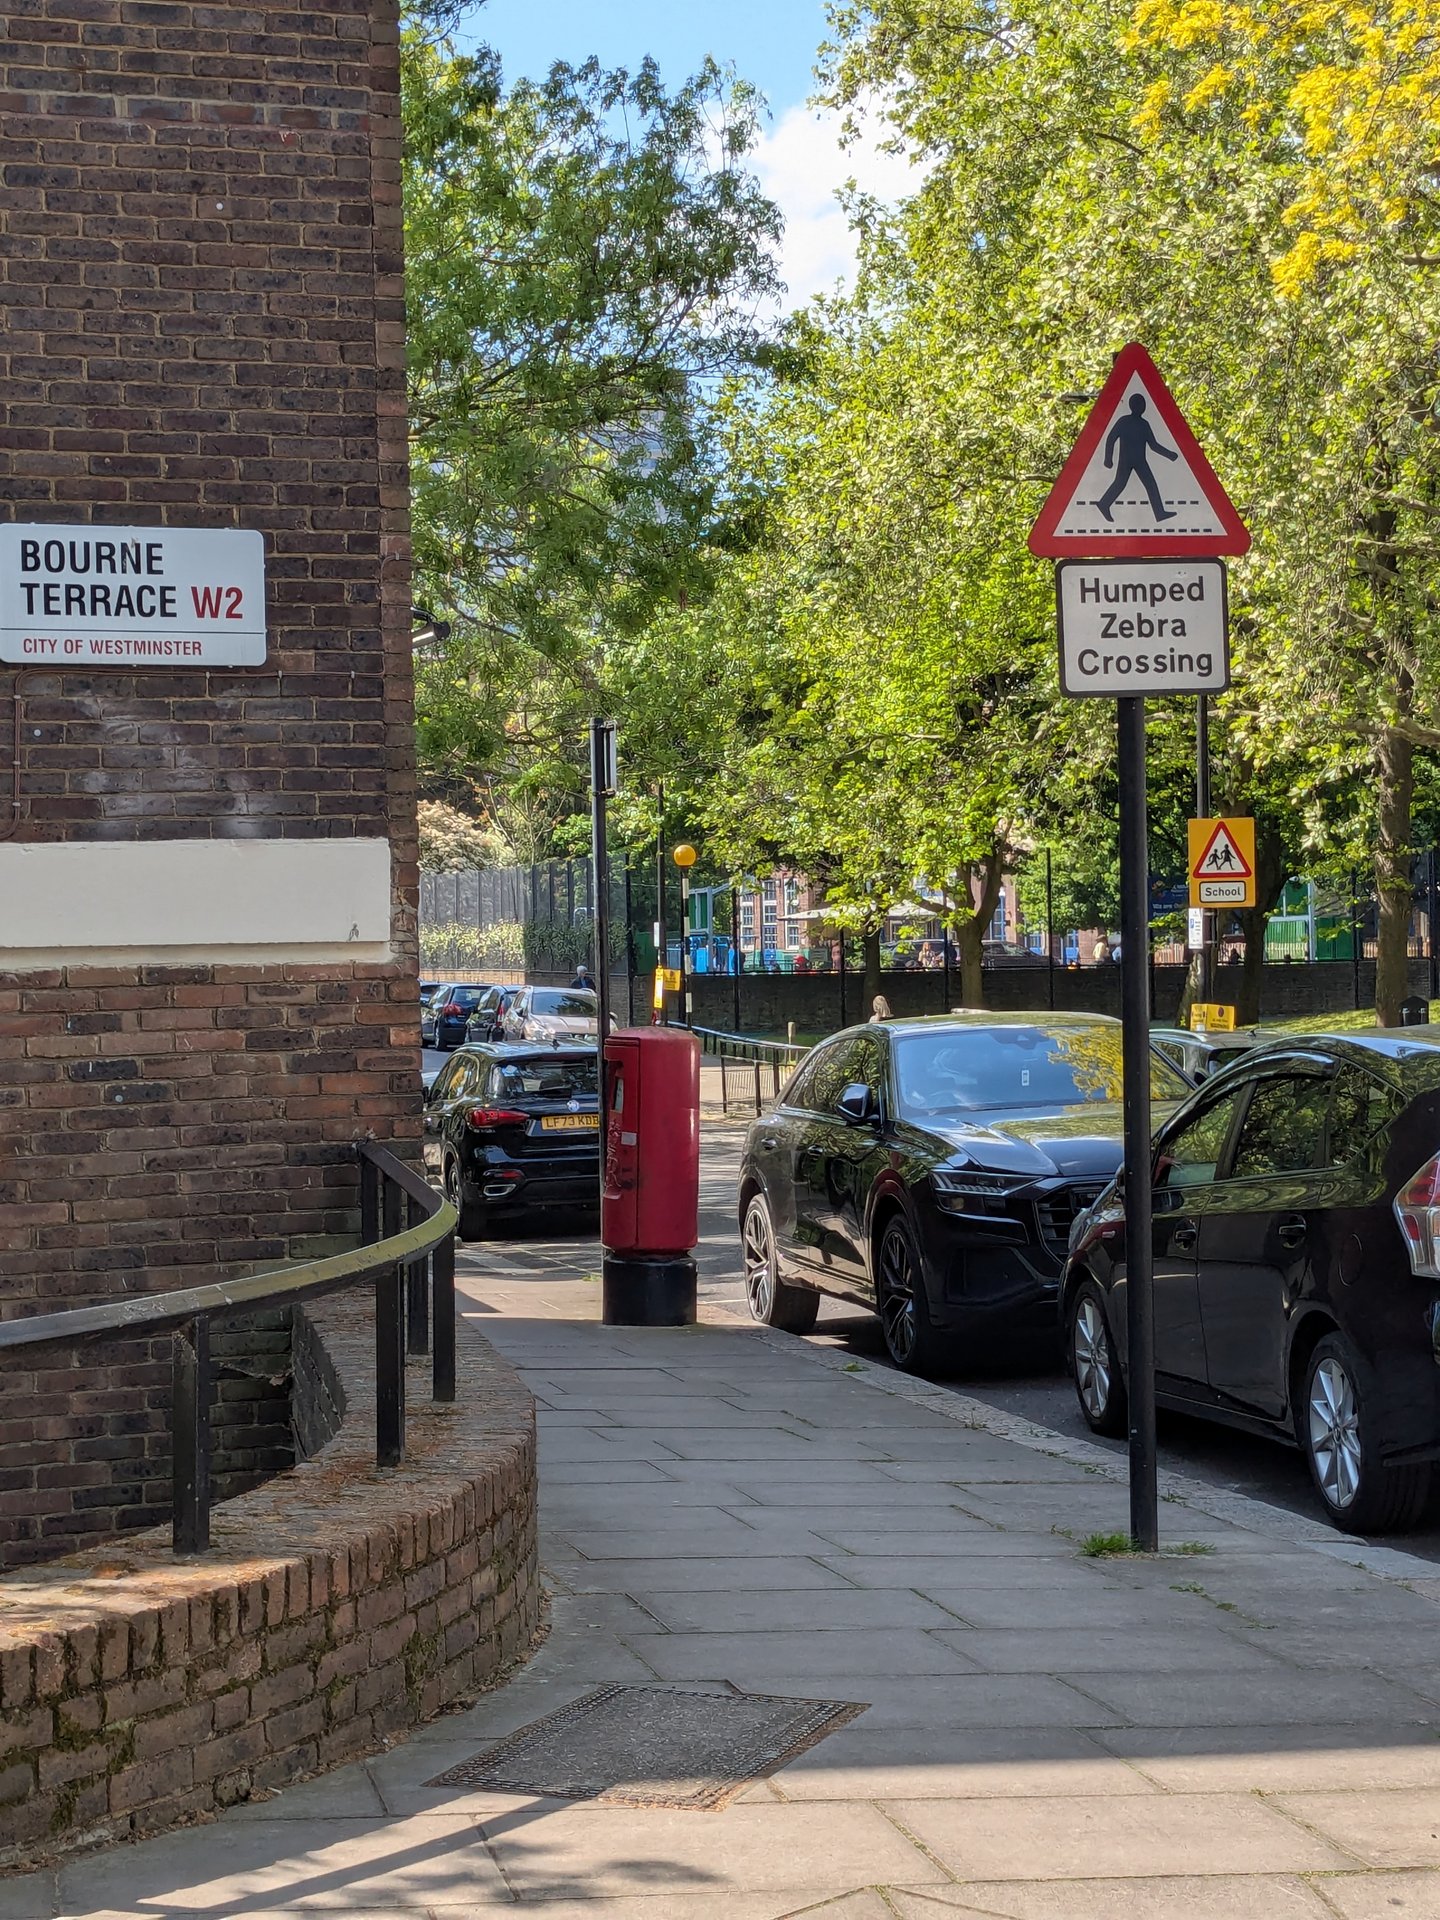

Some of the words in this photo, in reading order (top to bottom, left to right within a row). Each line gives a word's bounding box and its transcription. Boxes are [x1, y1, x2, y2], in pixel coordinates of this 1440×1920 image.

[20, 539, 164, 575] BOURNE
[20, 582, 177, 618] TERRACE
[191, 586, 244, 619] W2
[1080, 575, 1205, 607] Humped
[1100, 612, 1187, 639] Zebra
[23, 638, 58, 654] CITY
[63, 639, 84, 655] OF
[89, 639, 202, 656] WESTMINSTER
[1077, 647, 1213, 678] Crossing
[1205, 886, 1241, 897] School
[545, 1116, 575, 1128] LF73
